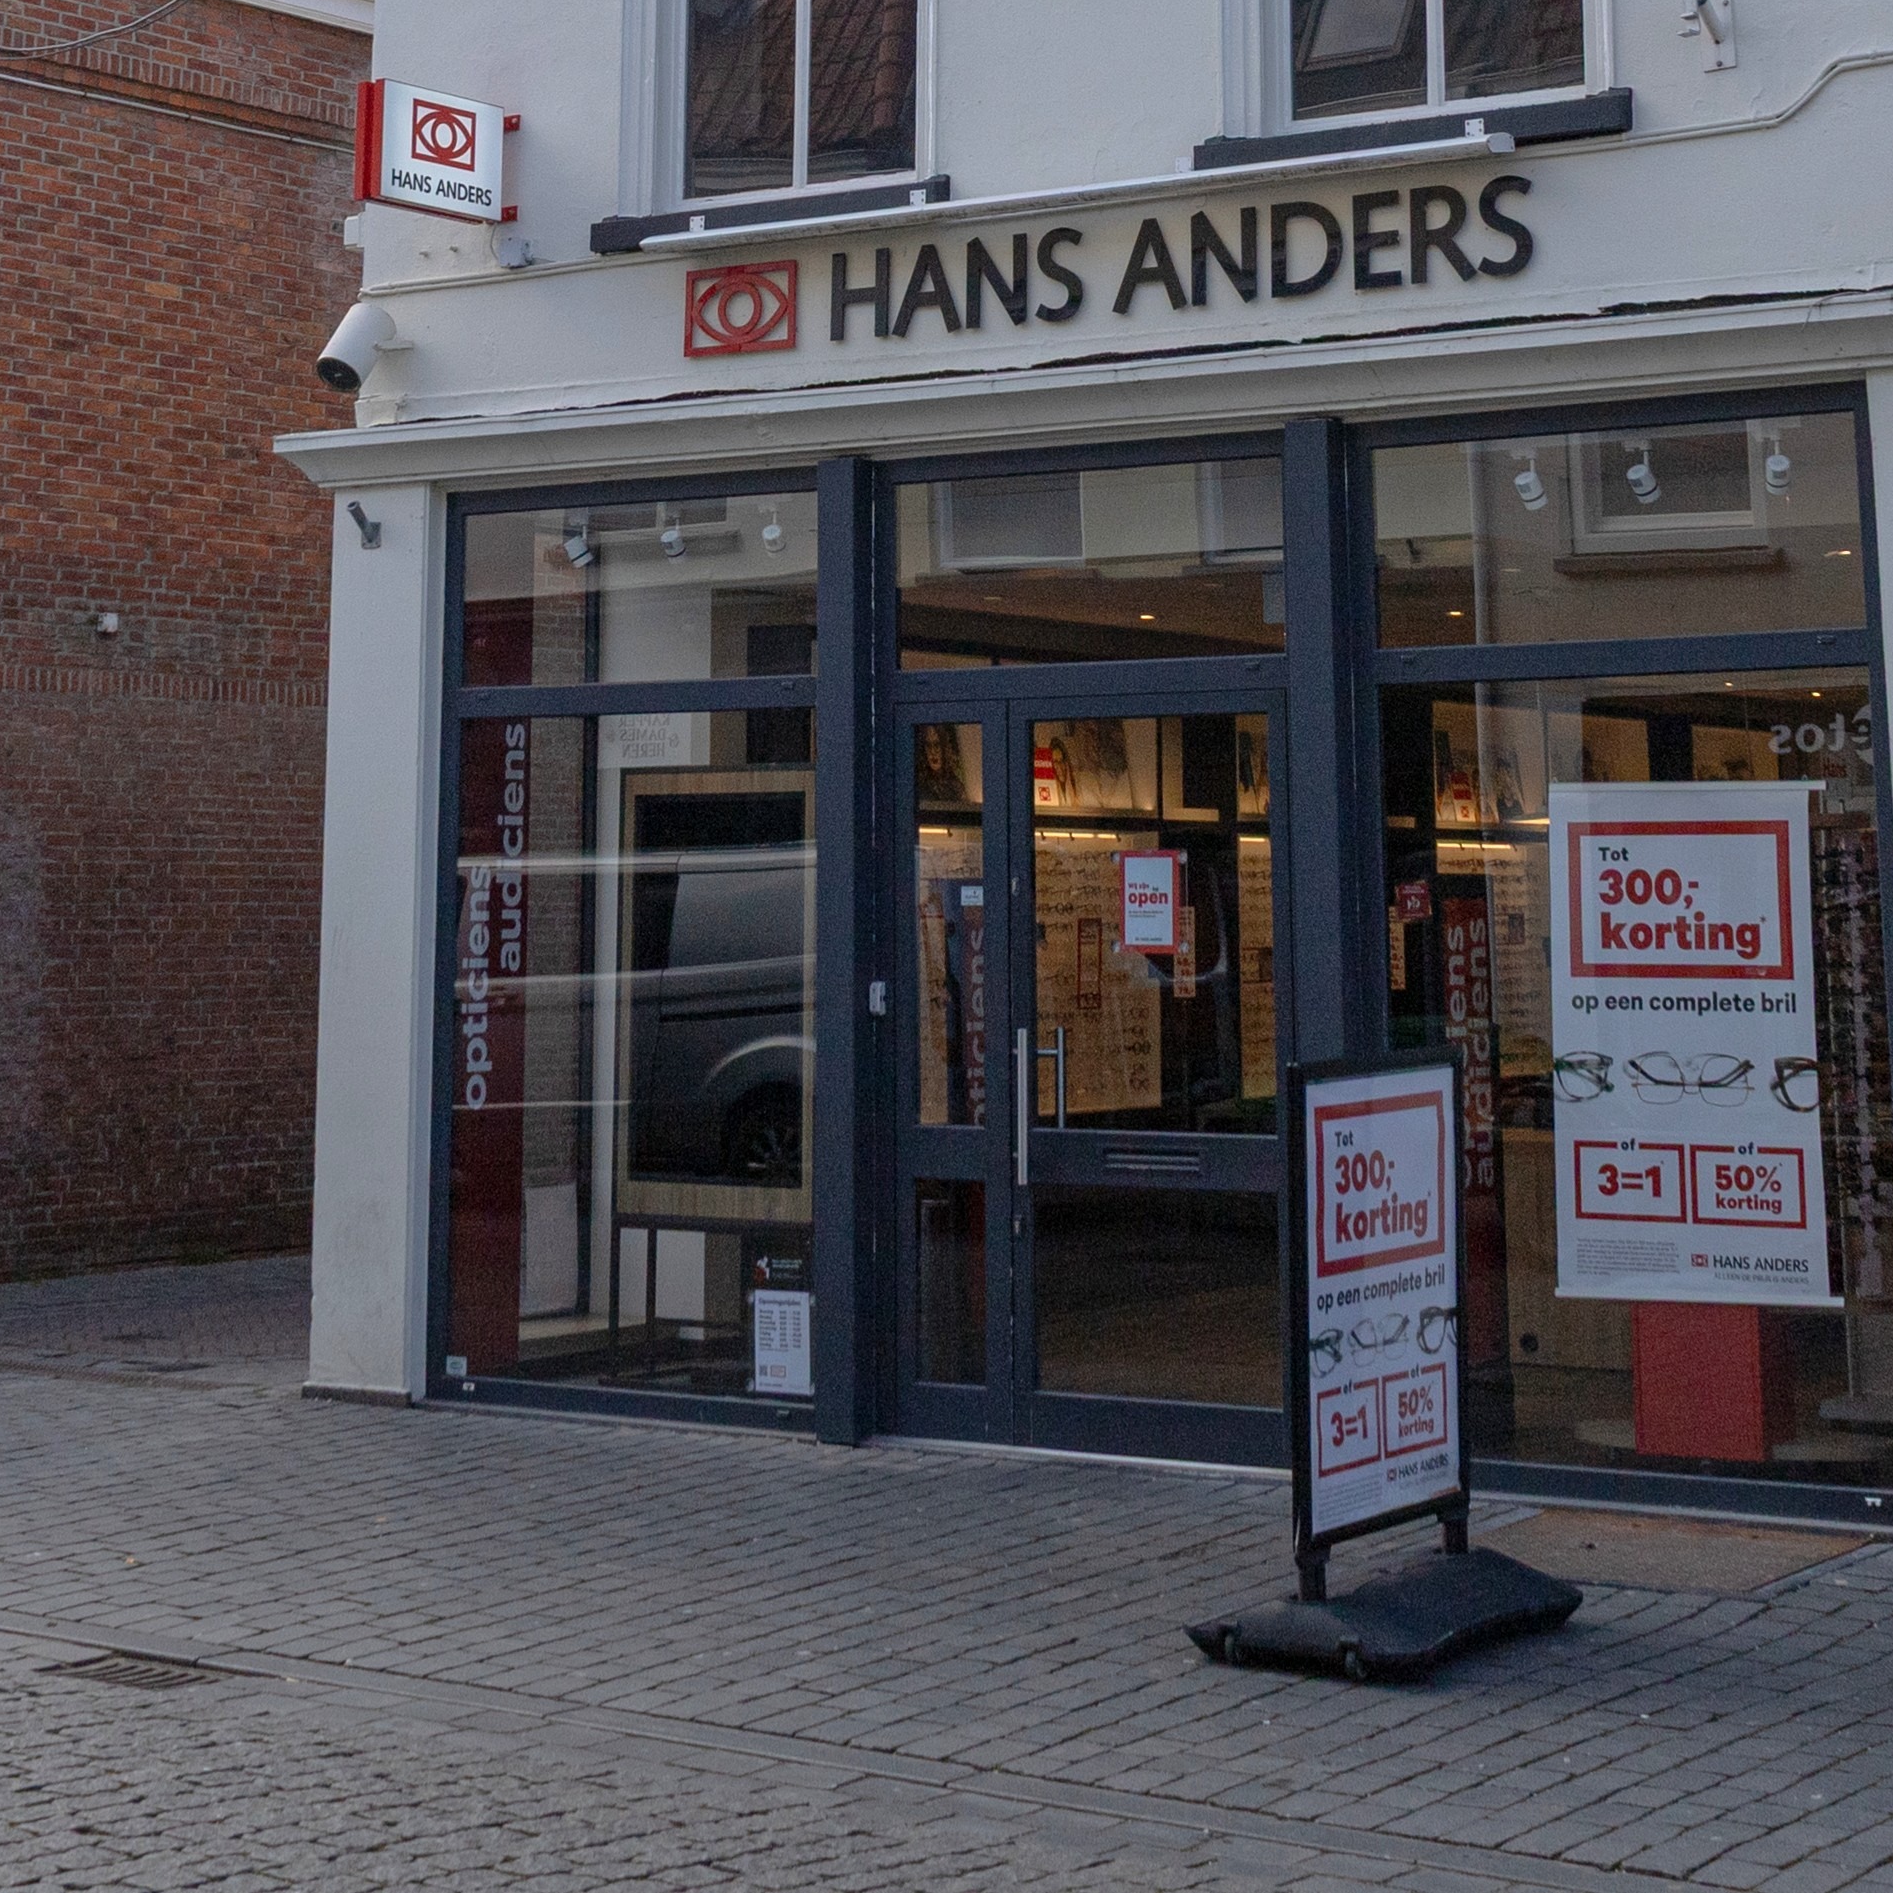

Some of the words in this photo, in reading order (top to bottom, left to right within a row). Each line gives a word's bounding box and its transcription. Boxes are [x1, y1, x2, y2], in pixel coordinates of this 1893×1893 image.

[392, 168, 432, 194] HANS
[435, 179, 492, 206] ANDERS
[830, 227, 1084, 342] HANS
[1112, 175, 1534, 315] ANDERS
[495, 723, 526, 973] audiciens
[1598, 846, 1629, 862] Tot
[1128, 891, 1168, 908] open
[1598, 868, 1700, 910] 300,-
[461, 863, 493, 1110] opticiens
[1571, 994, 1599, 1014] op
[1604, 994, 1643, 1010] een
[1649, 991, 1755, 1016] complete
[1760, 991, 1797, 1013] bril
[1334, 1130, 1354, 1148] Tot
[1621, 1138, 1636, 1151] of
[1738, 1142, 1754, 1155] of
[1715, 1193, 1782, 1215] korting
[1713, 1255, 1750, 1270] HANS
[1754, 1257, 1808, 1273] ANDERS
[1317, 1292, 1333, 1314] op
[1337, 1285, 1360, 1306] een
[1363, 1273, 1422, 1301] complete
[1424, 1263, 1445, 1288] bril
[1398, 1464, 1419, 1480] HANS
